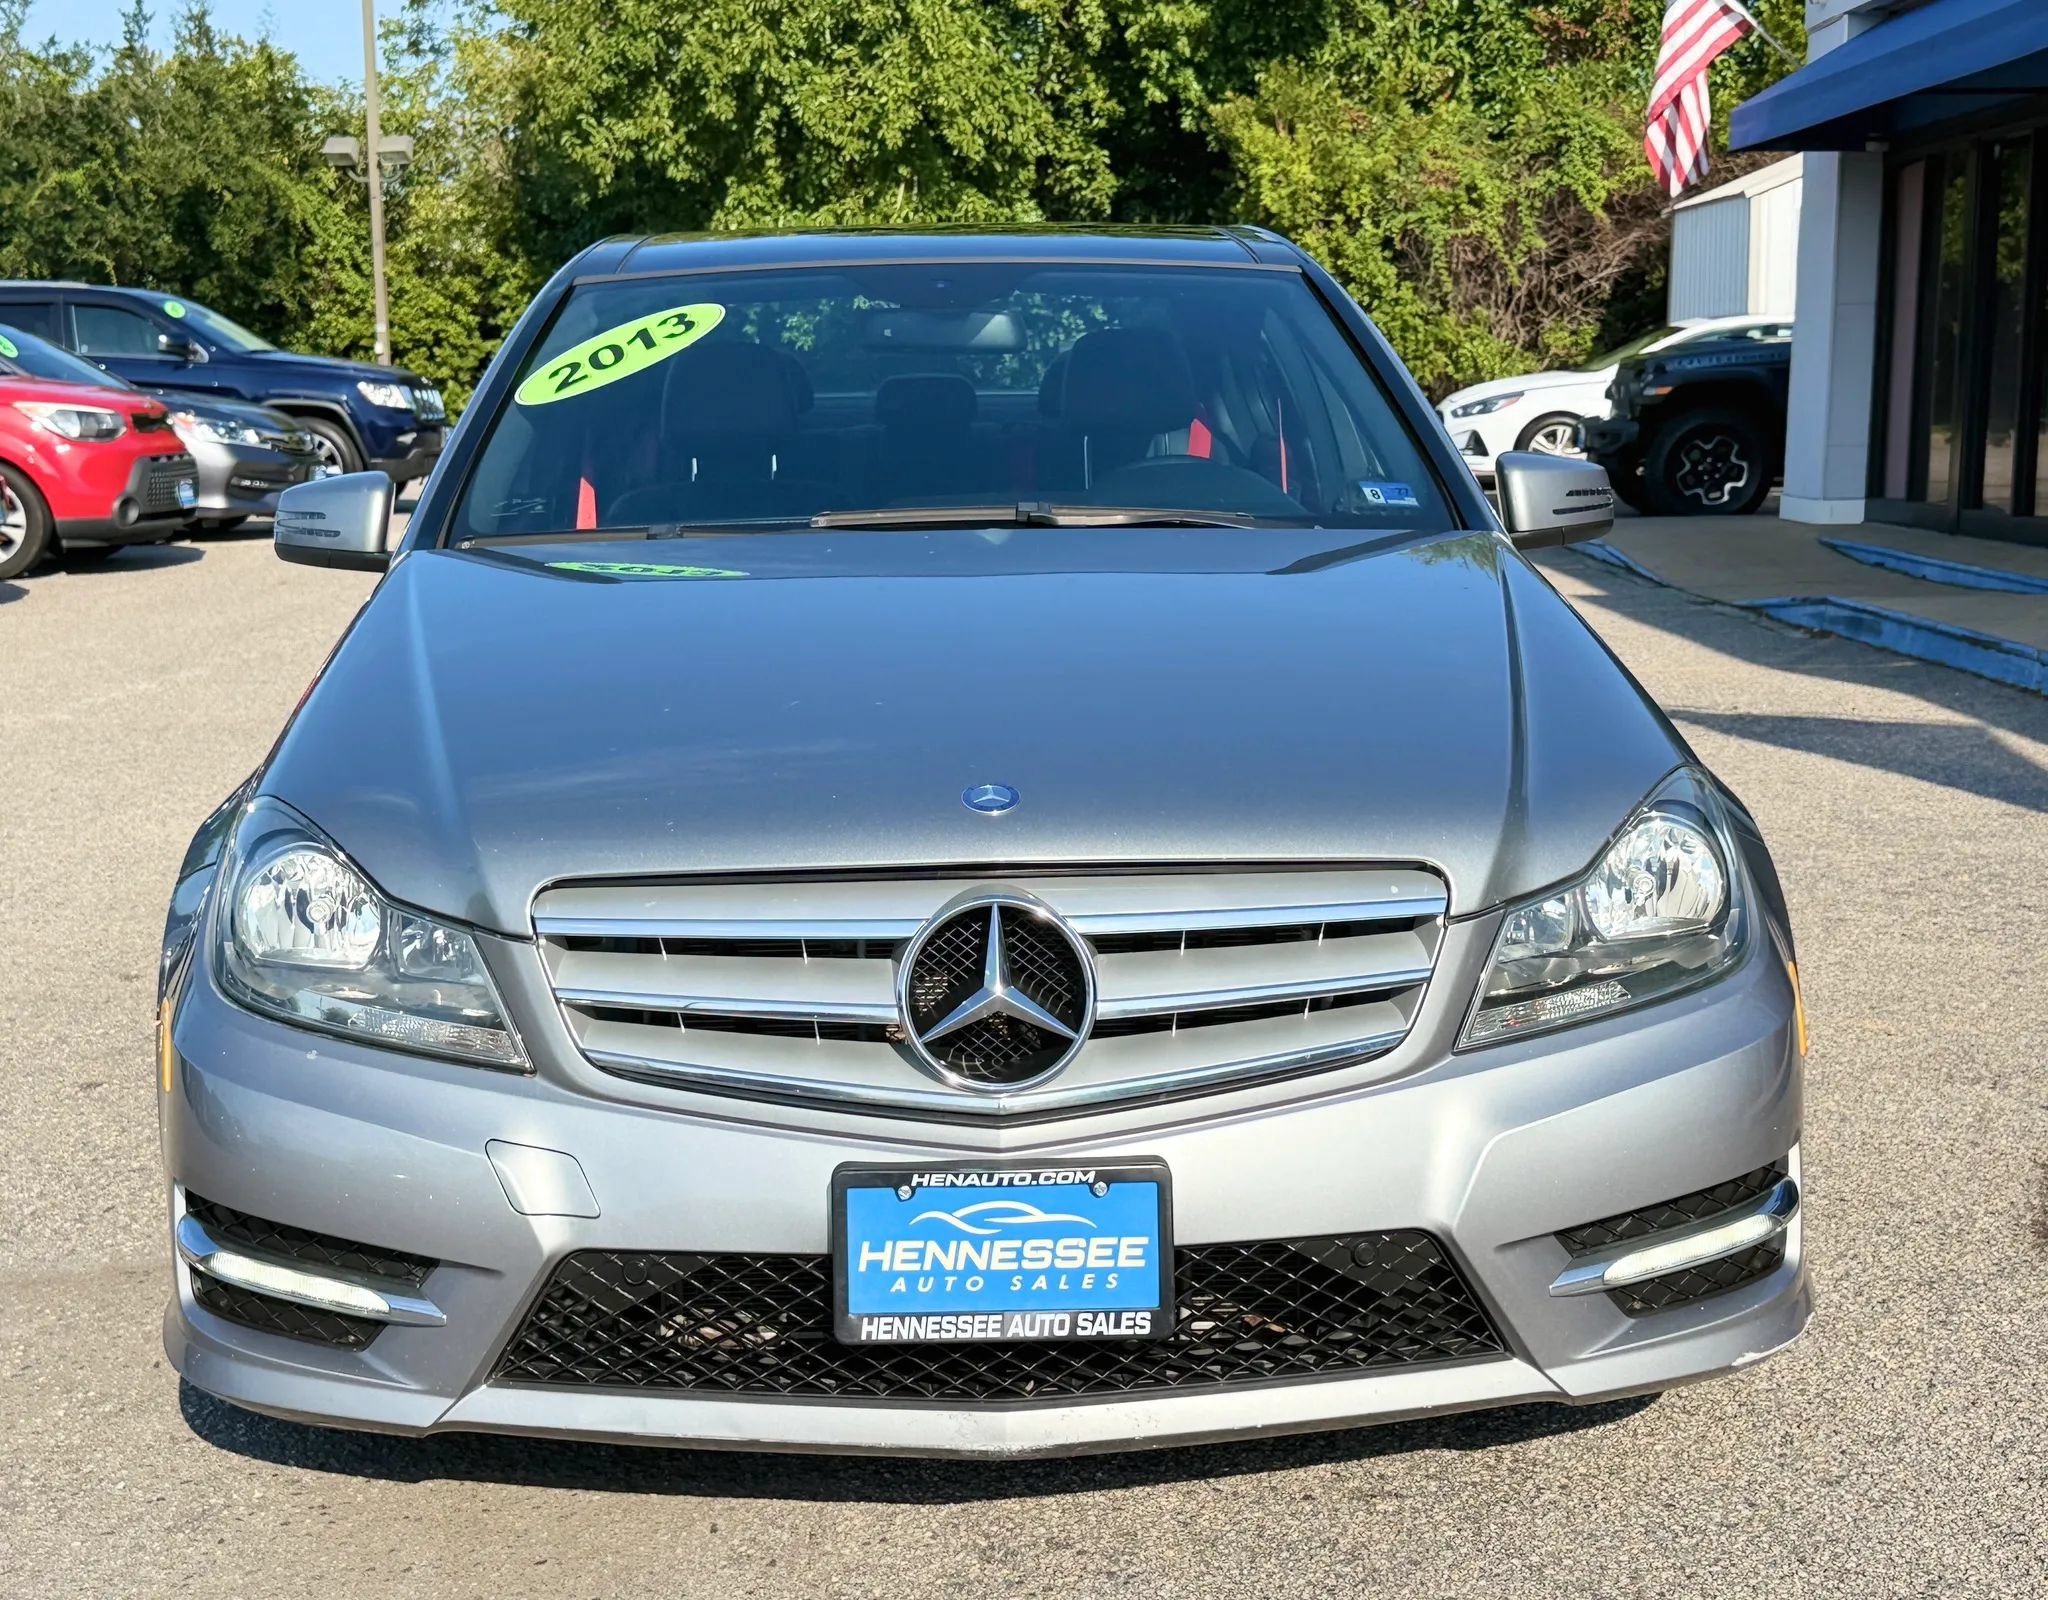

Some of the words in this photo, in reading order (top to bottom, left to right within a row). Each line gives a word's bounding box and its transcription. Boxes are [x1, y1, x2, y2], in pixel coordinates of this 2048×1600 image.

[548, 313, 696, 394] 2013
[1370, 489, 1381, 499] 8
[911, 1170, 1096, 1187] HENAUTO.COM
[858, 1237, 1149, 1272] HENNESSEE
[890, 1275, 984, 1293] AUTO
[1009, 1272, 1119, 1292] SALES
[861, 1314, 1002, 1340] HENNESSEE
[1006, 1312, 1071, 1338] AUTO
[1076, 1311, 1152, 1336] SALES
